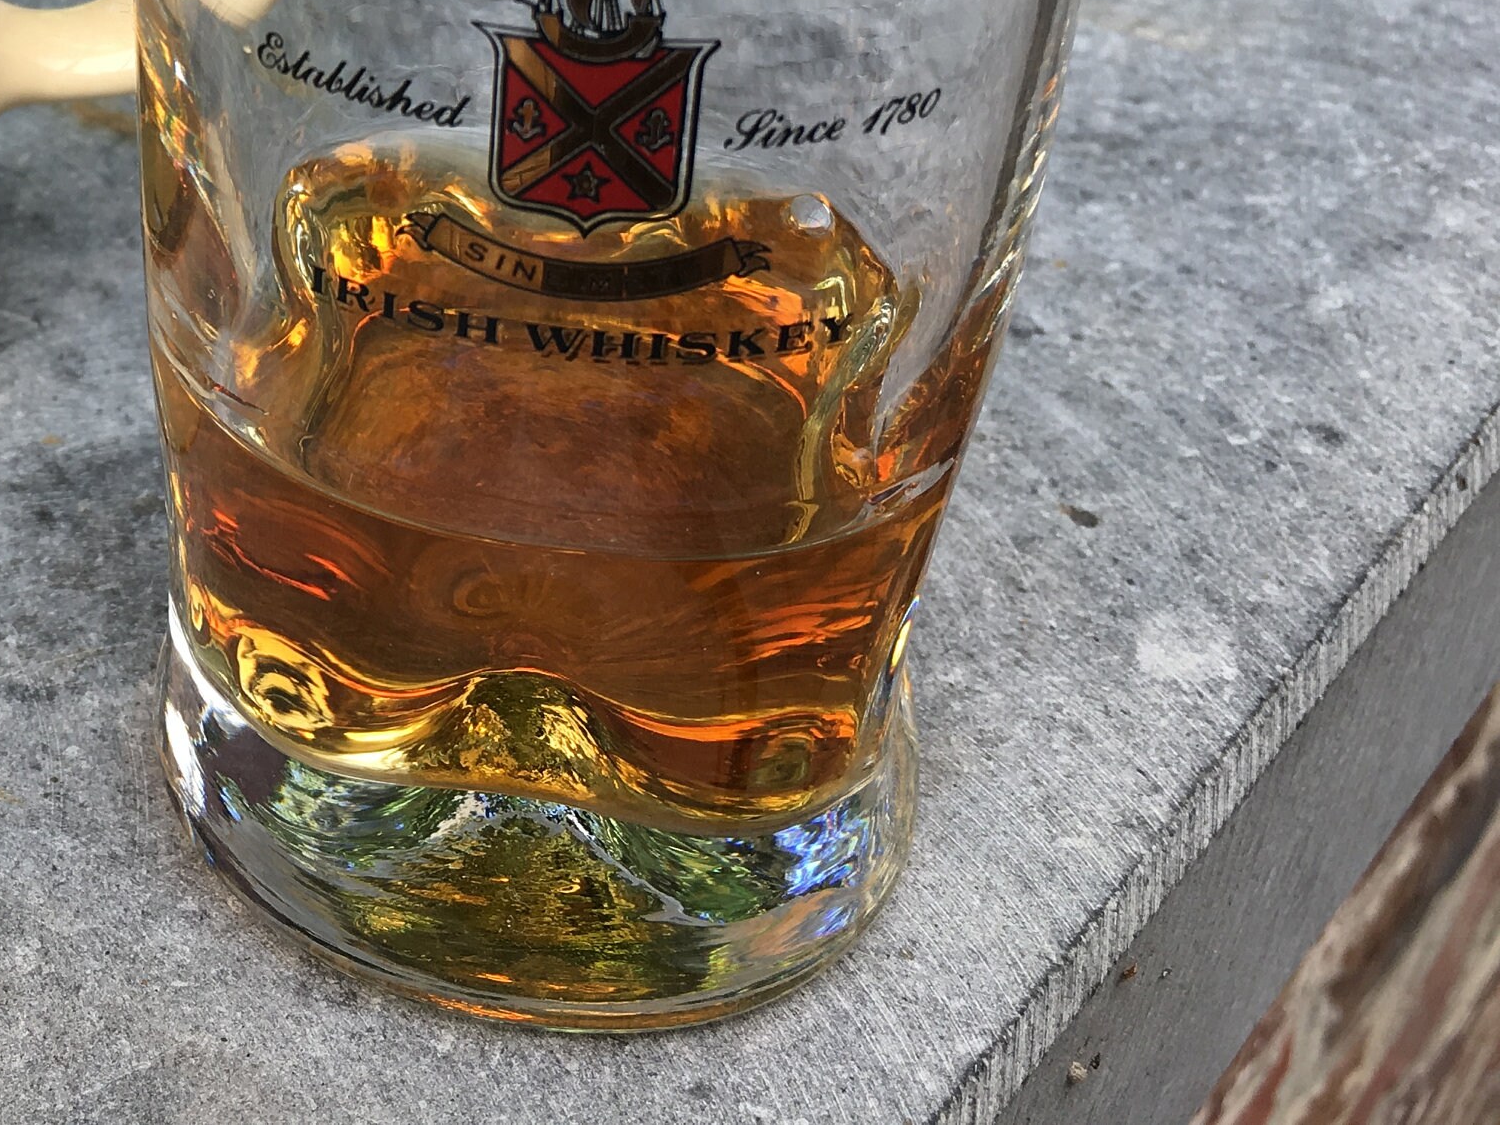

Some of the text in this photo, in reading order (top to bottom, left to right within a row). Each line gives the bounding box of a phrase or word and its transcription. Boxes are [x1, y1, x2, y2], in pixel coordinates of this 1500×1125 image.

[257, 31, 472, 128] Established
[723, 87, 941, 152] Since 1780
[310, 264, 853, 365] IRISH WHISKEY
